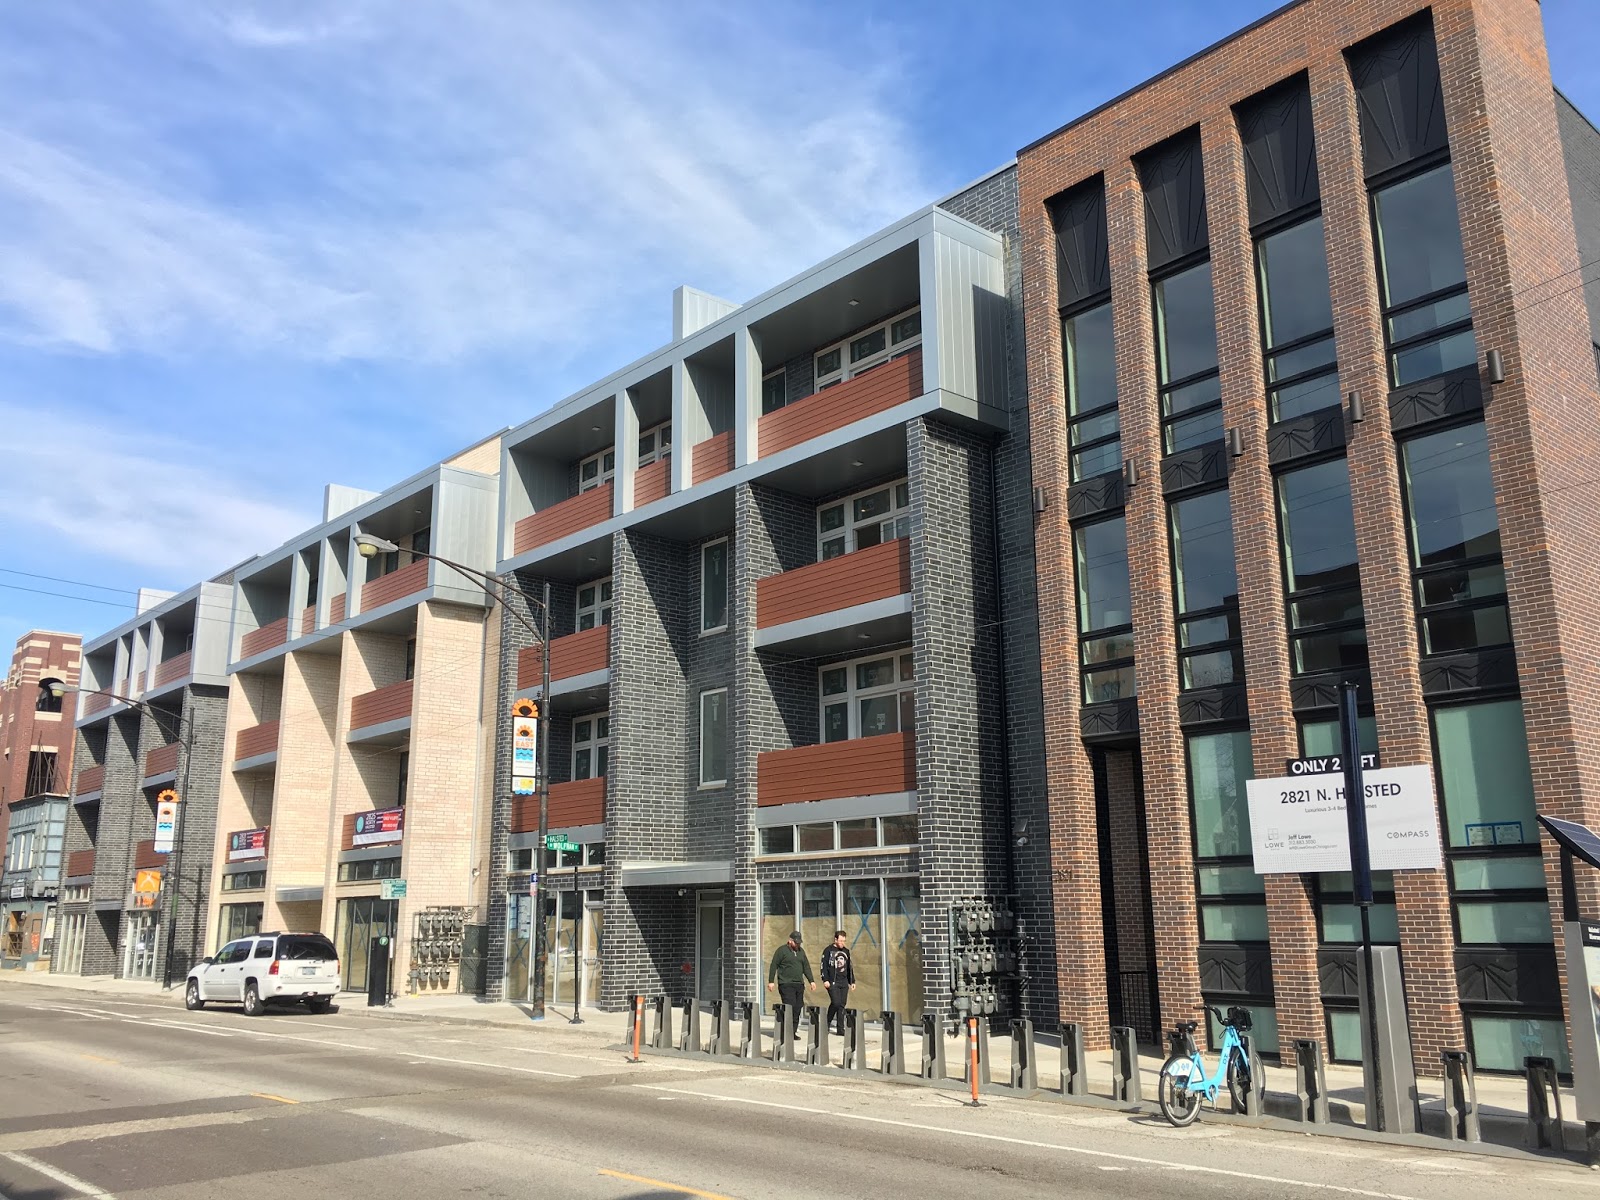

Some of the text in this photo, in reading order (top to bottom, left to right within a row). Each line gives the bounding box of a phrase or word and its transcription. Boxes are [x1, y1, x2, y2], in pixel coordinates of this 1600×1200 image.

[1291, 758, 1328, 774] ONLY
[1331, 757, 1341, 770] 2
[1280, 783, 1402, 804] 2821 N. HSTED
[1386, 830, 1430, 839] COMPASS
